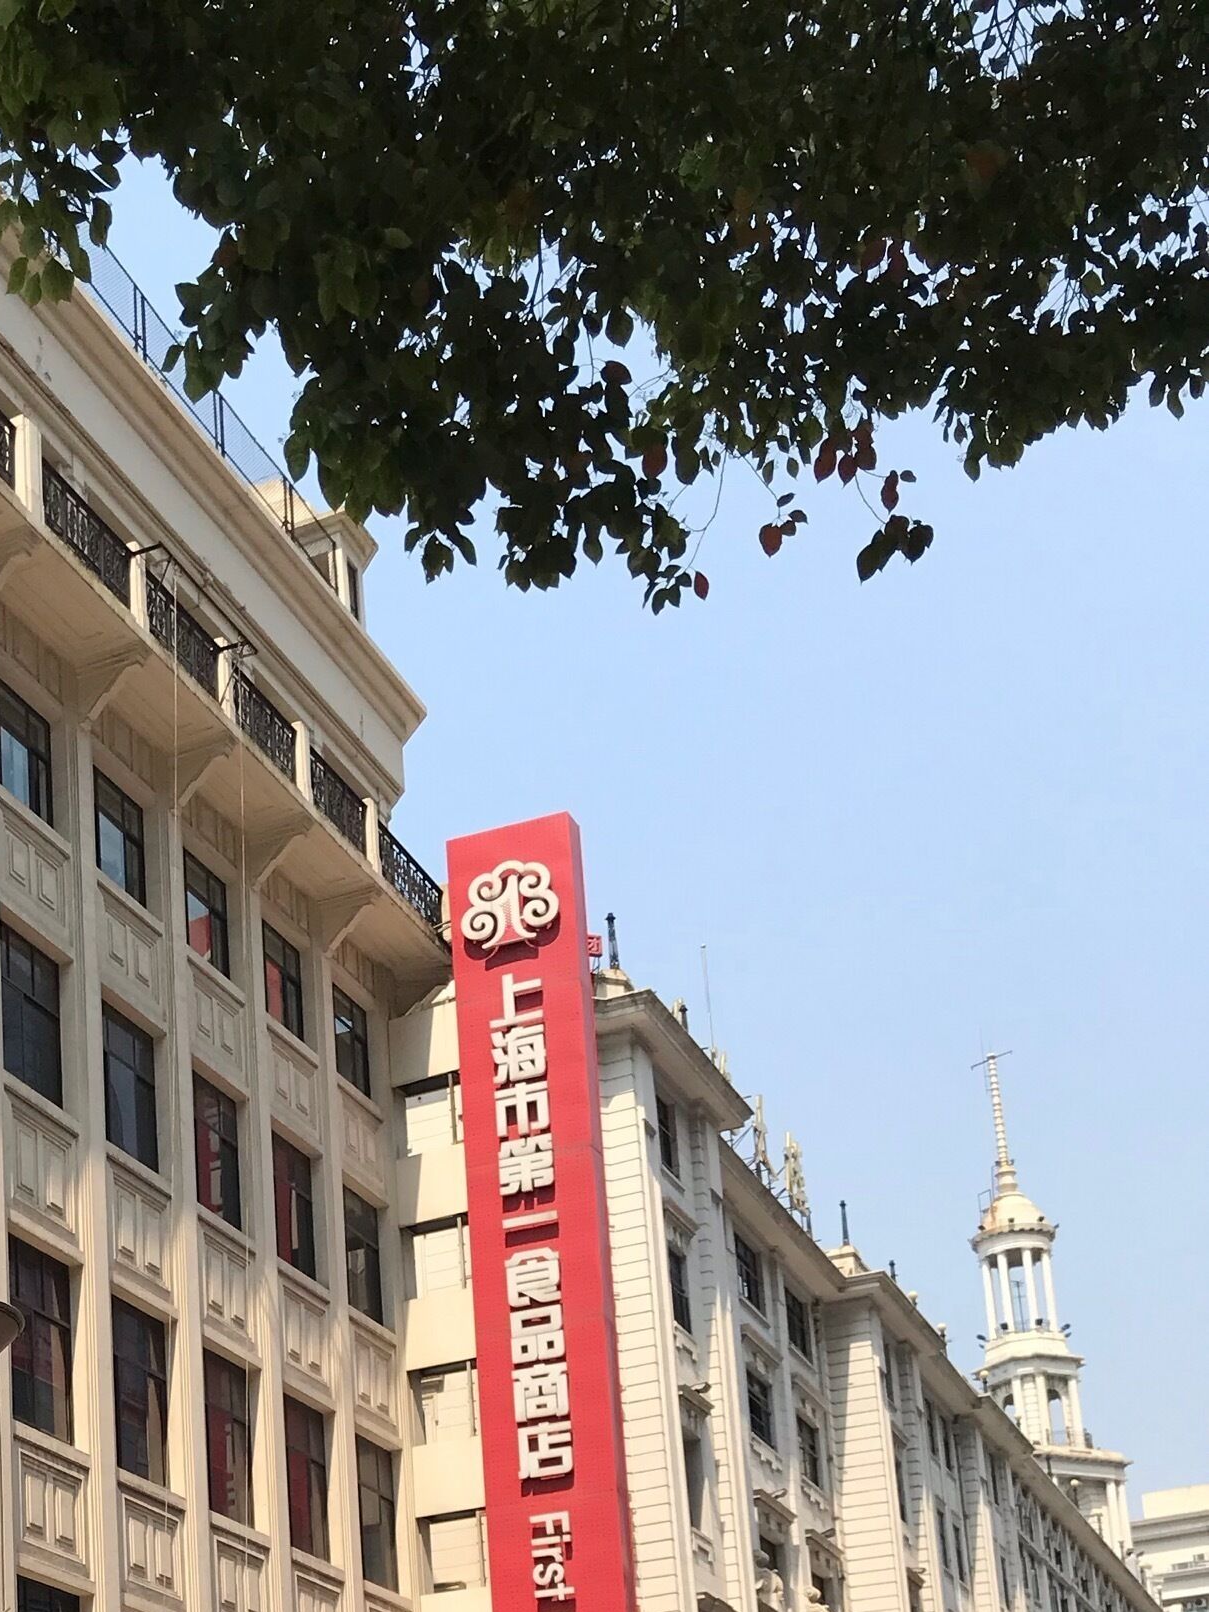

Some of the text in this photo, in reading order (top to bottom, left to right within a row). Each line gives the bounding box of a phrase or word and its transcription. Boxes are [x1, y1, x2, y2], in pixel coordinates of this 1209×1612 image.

[489, 973, 574, 1480] 上海市第一食品商店
[529, 1510, 576, 1602] First
